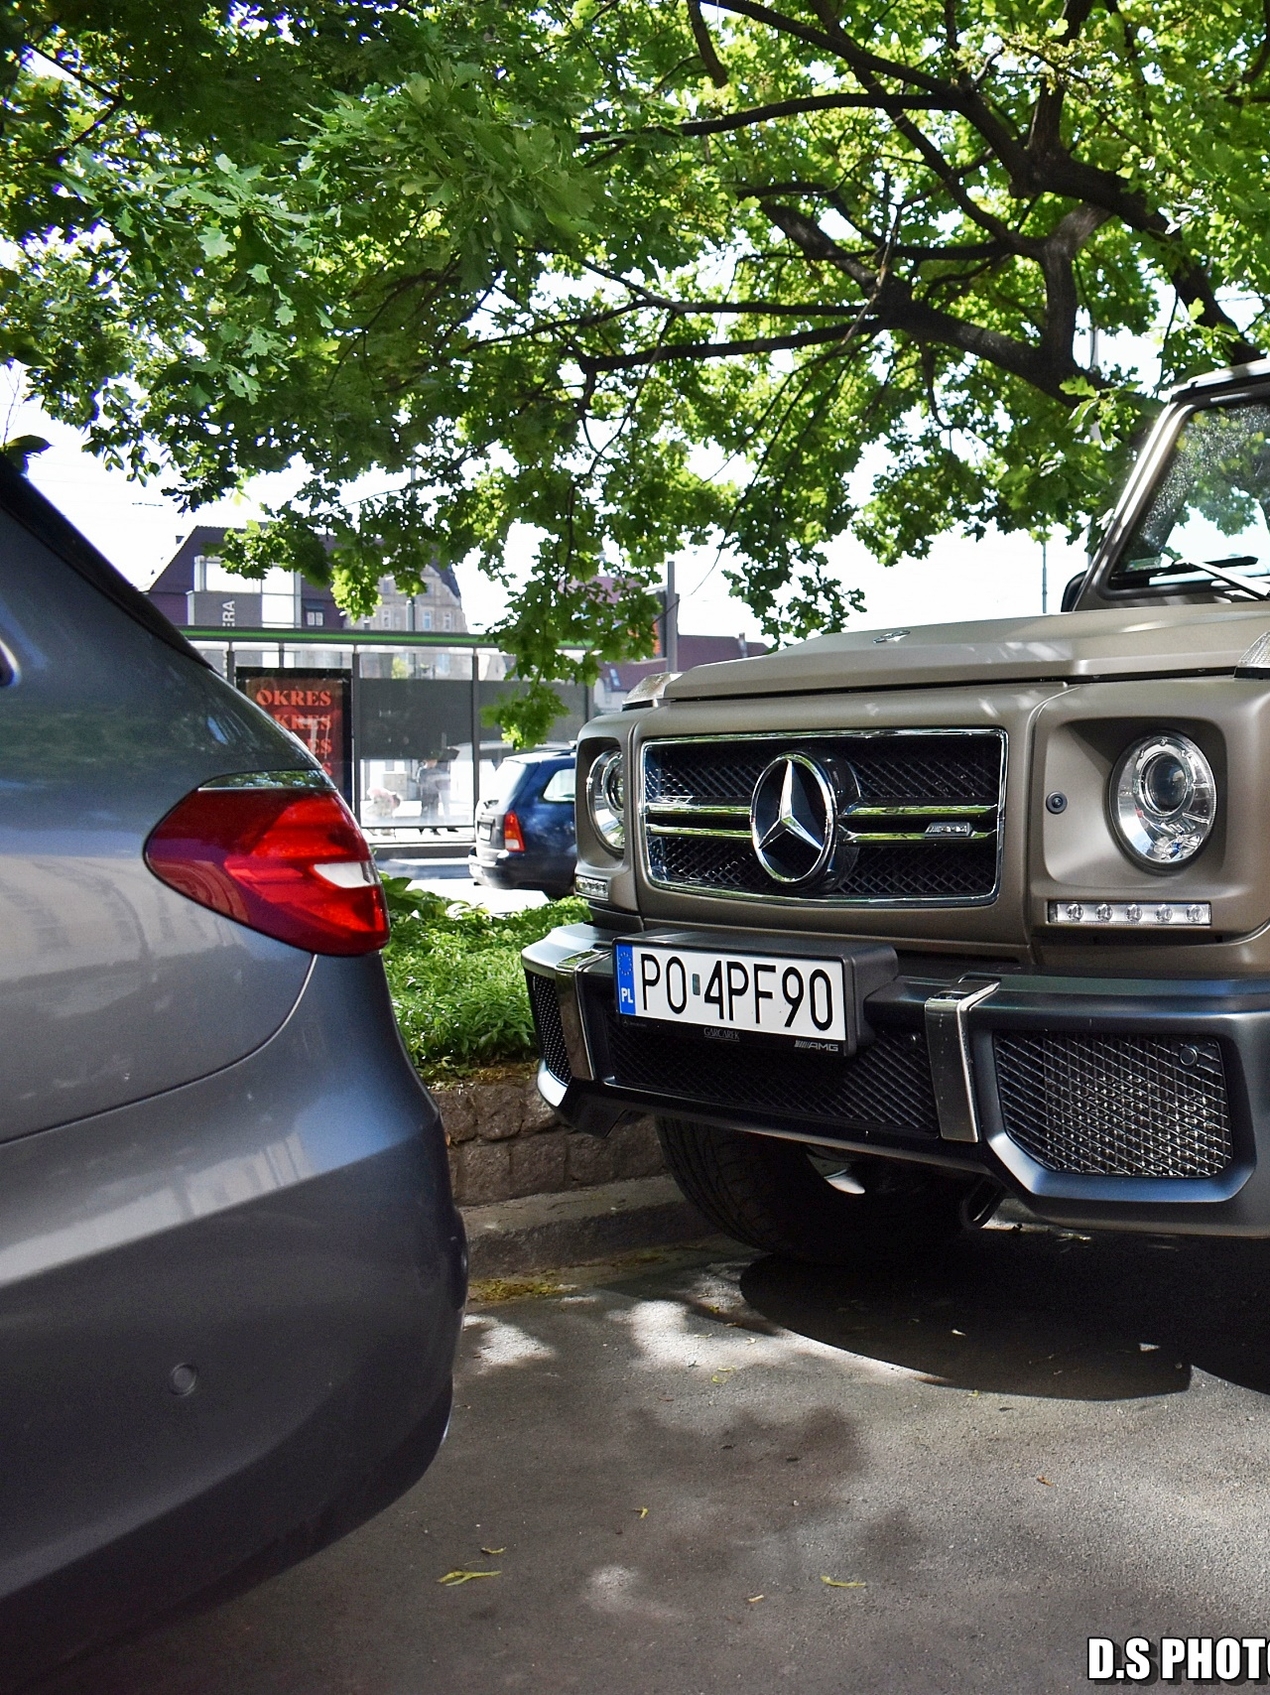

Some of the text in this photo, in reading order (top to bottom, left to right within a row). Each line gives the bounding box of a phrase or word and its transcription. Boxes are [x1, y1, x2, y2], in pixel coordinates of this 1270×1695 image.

[256, 690, 332, 706] OKRES
[273, 714, 332, 730] KRES
[621, 987, 634, 1004] PL
[641, 953, 833, 1032] PO 4PF90
[808, 1041, 839, 1052] AMG
